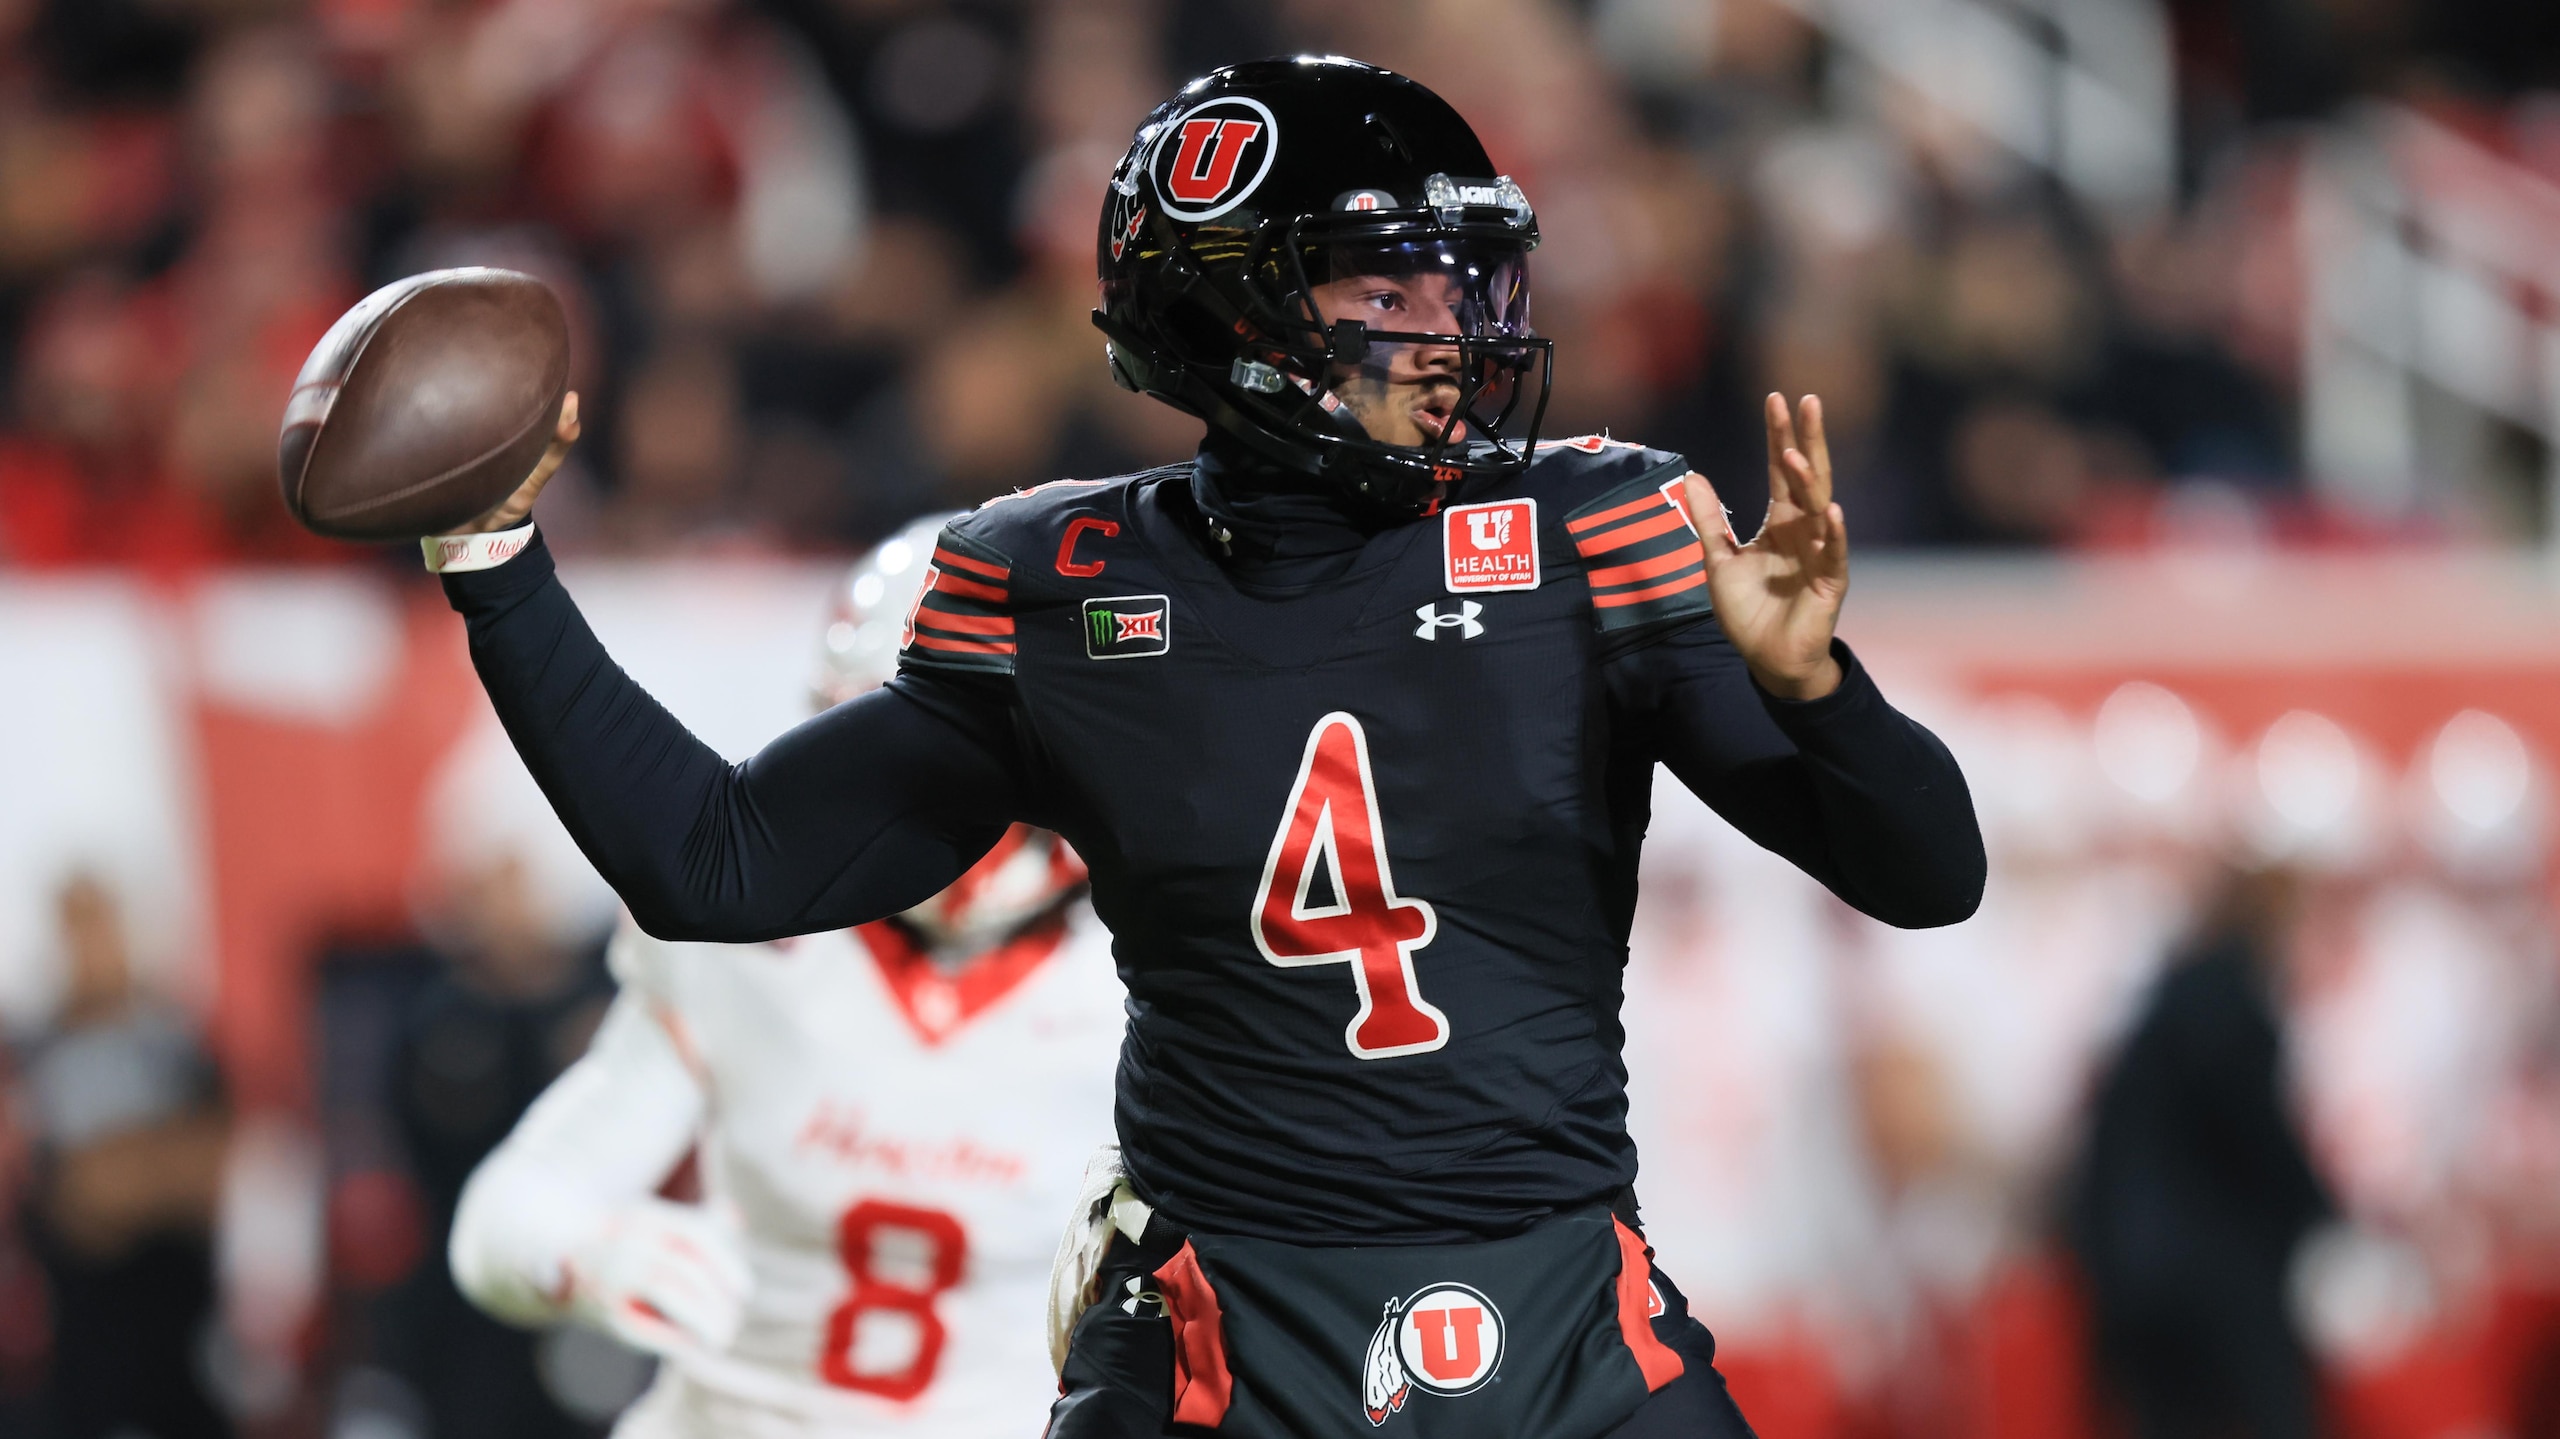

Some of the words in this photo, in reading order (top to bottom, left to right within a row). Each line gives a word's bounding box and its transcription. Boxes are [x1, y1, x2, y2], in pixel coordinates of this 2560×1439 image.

[1168, 117, 1262, 203] U
[1055, 516, 1120, 578] C
[1454, 553, 1530, 573] HEALTH
[1454, 574, 1497, 583] UNIVERSITY
[1498, 573, 1509, 581] OF
[1510, 572, 1531, 581] UTAH
[1250, 710, 1450, 1060] 4
[818, 1196, 966, 1404] 8
[1413, 1306, 1483, 1381] U
